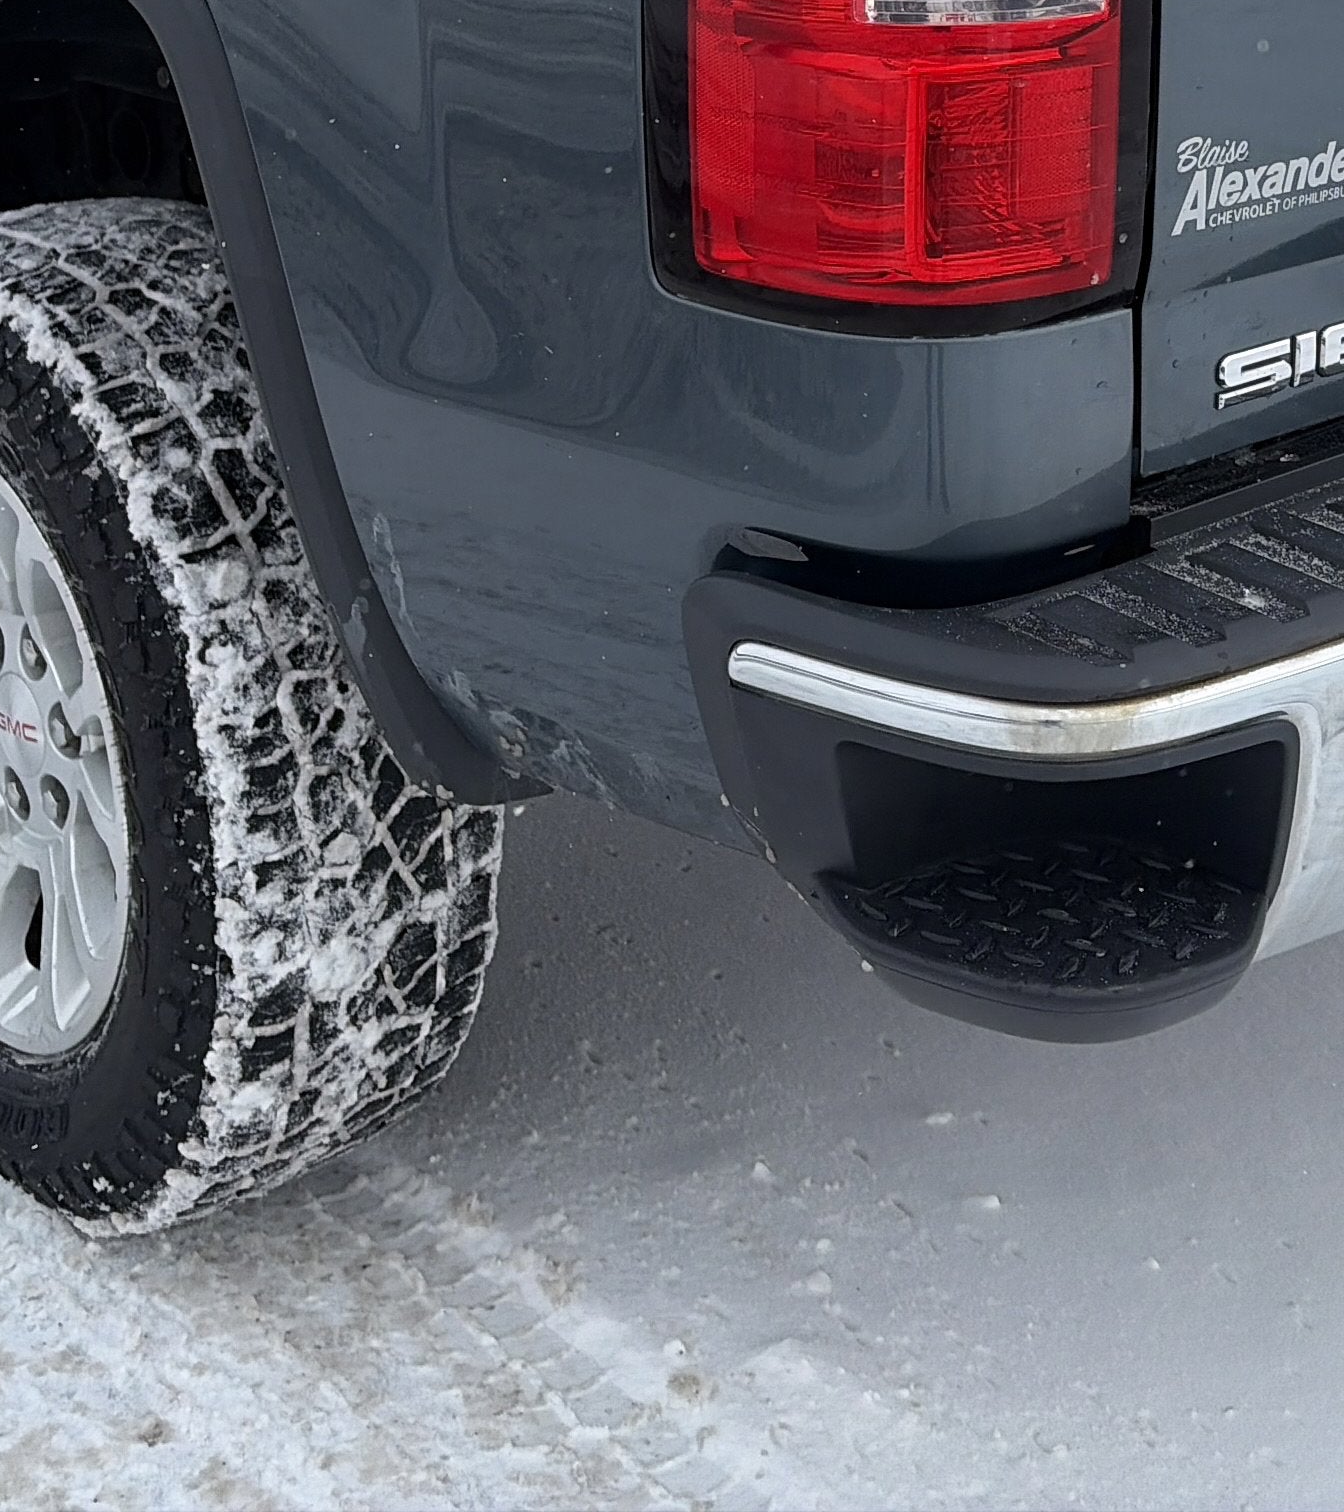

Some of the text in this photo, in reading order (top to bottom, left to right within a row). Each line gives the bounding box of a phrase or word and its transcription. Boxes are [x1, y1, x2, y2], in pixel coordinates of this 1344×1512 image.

[1176, 136, 1249, 173] Blaise
[1209, 197, 1280, 228] CHEVROLET
[1283, 196, 1297, 211] OF
